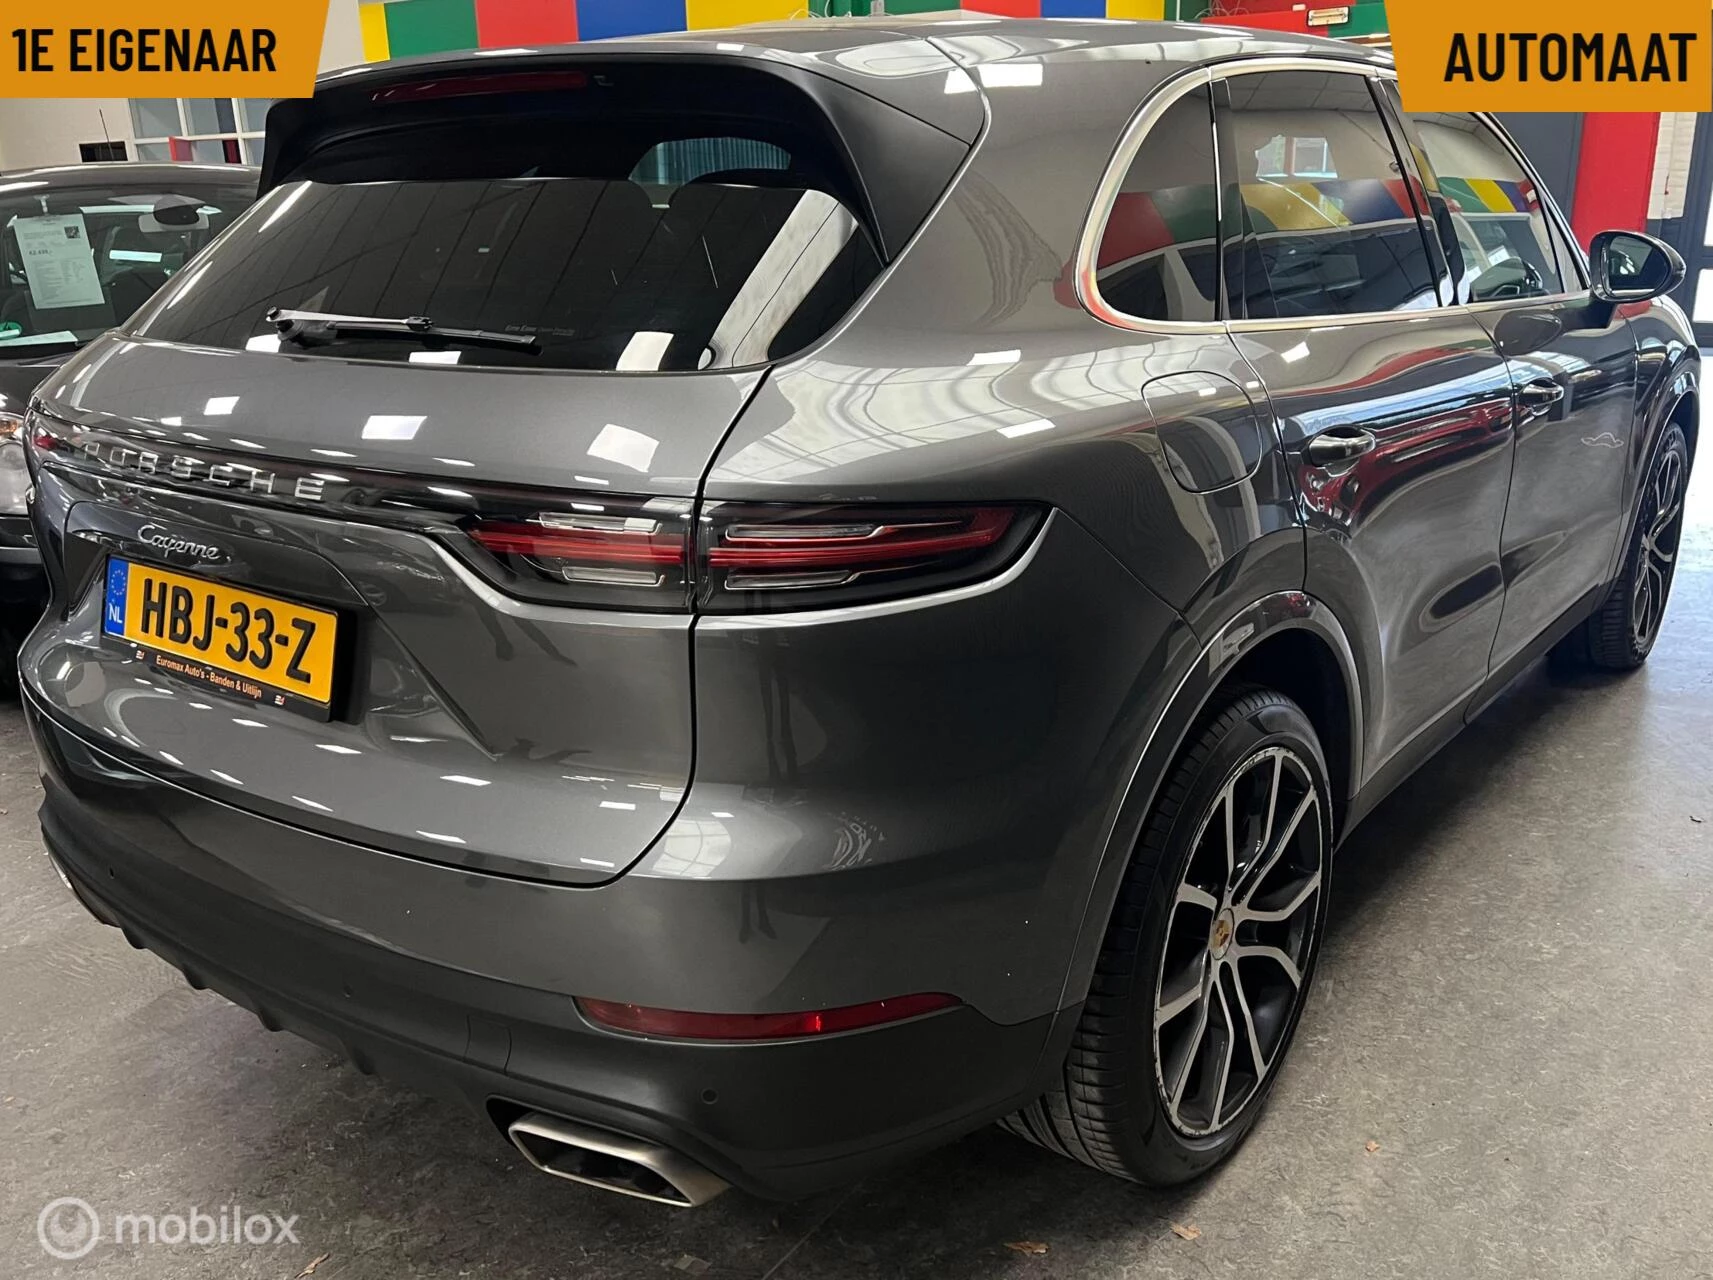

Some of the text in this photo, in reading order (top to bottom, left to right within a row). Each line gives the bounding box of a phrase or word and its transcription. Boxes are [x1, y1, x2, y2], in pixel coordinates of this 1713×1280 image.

[84, 441, 325, 501] PORSCHE
[137, 525, 220, 561] Cayenne
[108, 602, 123, 624] NL
[140, 577, 317, 683] HBJ-33-Z
[156, 655, 184, 672] Euromax
[184, 664, 205, 679] Auto's
[210, 672, 235, 689] Banden
[235, 680, 241, 690] &
[242, 682, 262, 699] Uitlijn
